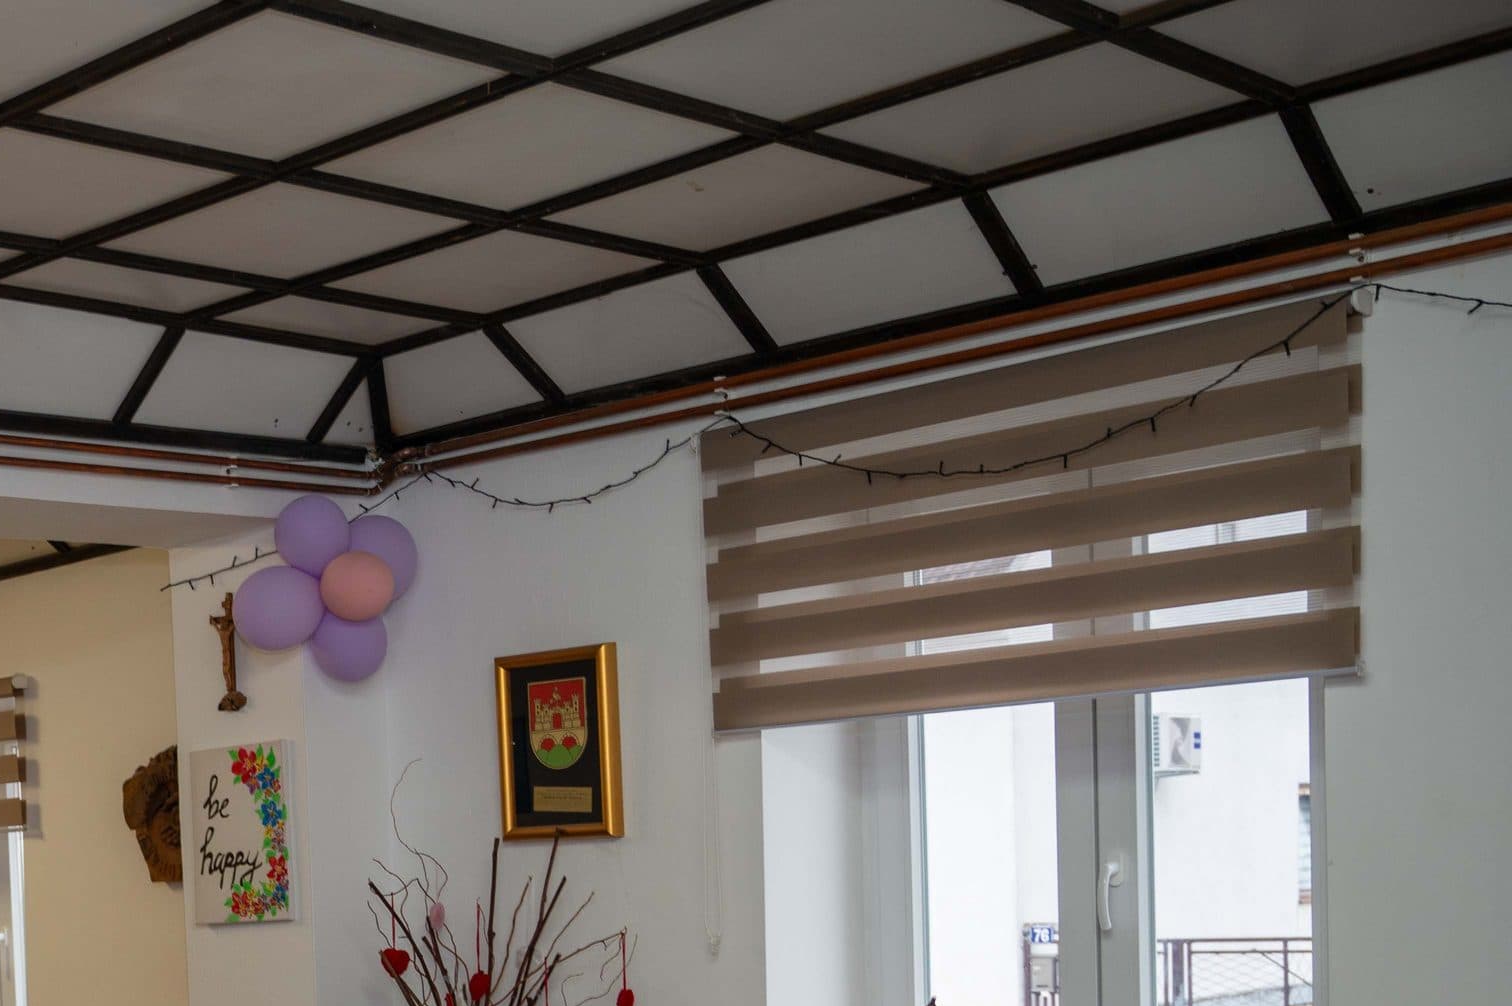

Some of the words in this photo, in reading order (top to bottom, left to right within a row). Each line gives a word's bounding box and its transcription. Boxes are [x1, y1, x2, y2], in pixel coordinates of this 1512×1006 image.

[203, 774, 230, 820] be
[200, 827, 263, 890] happy
[1033, 928, 1050, 943] 76
